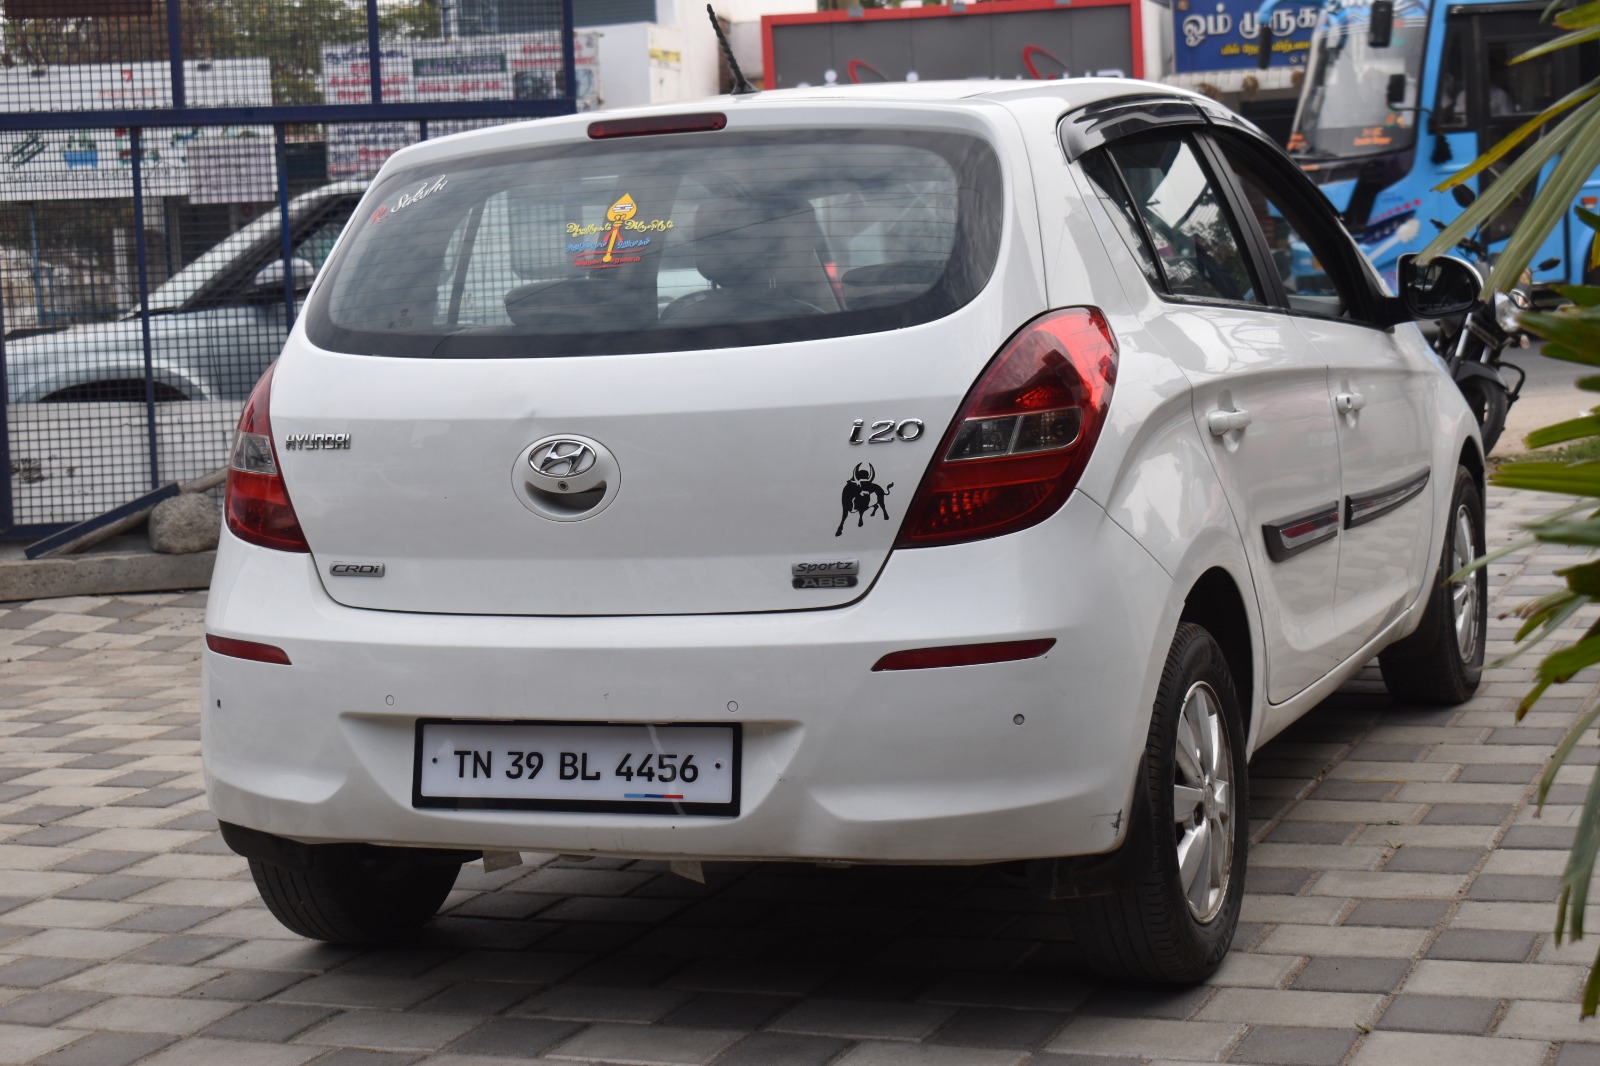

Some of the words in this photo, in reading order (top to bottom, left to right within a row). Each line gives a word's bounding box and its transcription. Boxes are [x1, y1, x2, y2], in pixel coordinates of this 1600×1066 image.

[1183, 3, 1232, 47] ஓம்
[285, 433, 350, 450] HYUNDAI
[849, 418, 924, 444] i20
[332, 564, 379, 573] CRDi
[802, 577, 849, 587] ABS
[454, 750, 492, 779] TN
[505, 751, 544, 780] 39
[559, 752, 601, 781] BL
[615, 753, 699, 783] 4456
